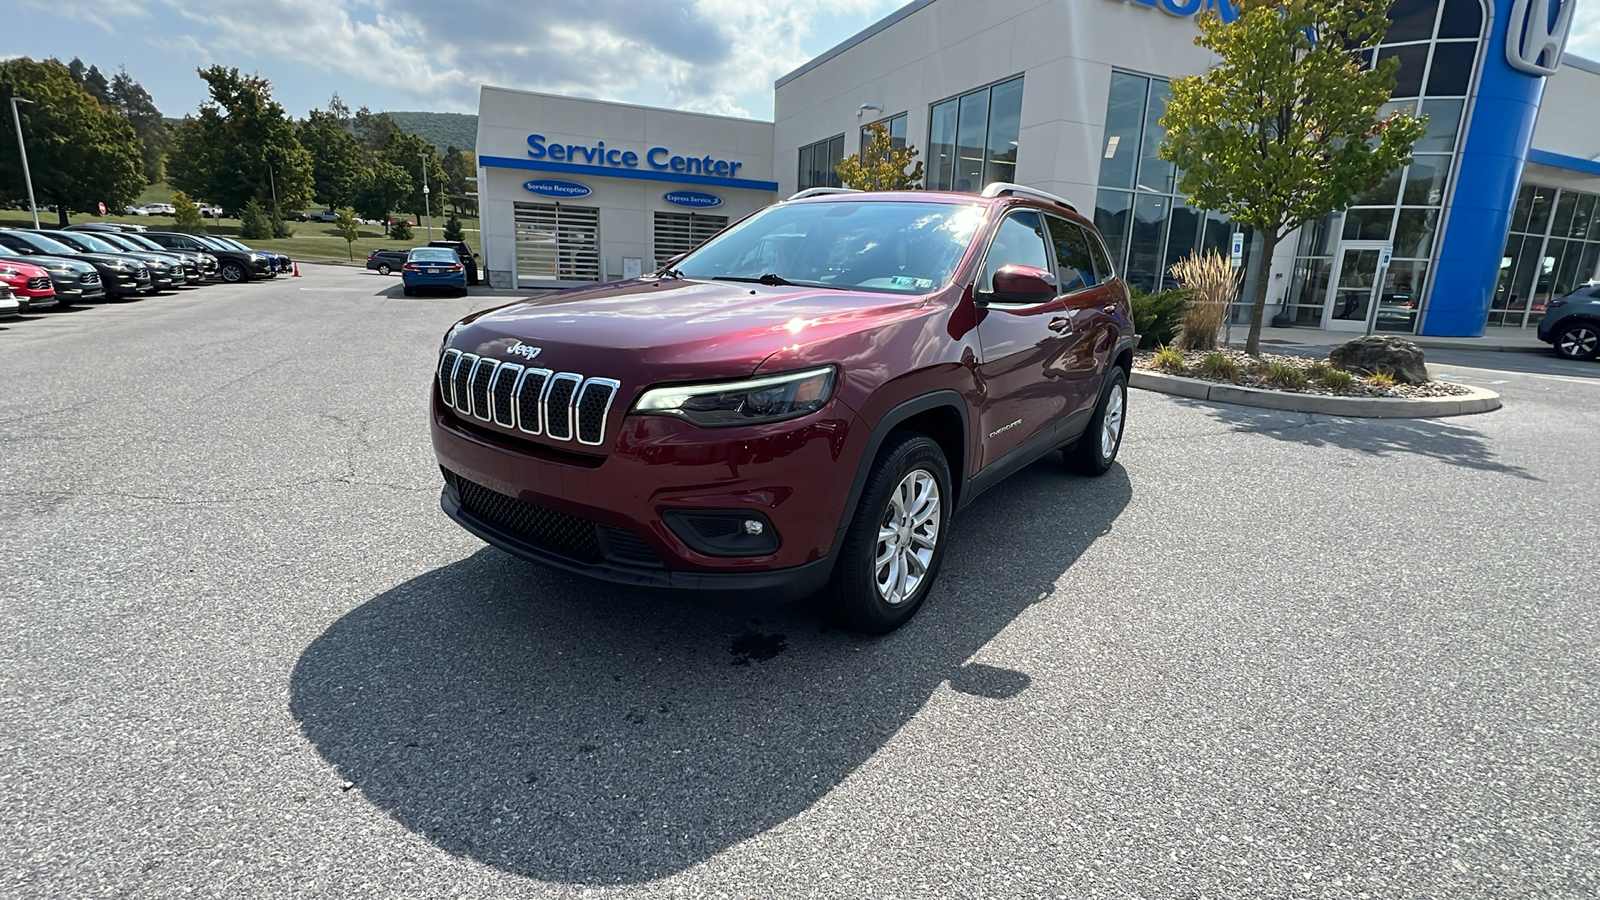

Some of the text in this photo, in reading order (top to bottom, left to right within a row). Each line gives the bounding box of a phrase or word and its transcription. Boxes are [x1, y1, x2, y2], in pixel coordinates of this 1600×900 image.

[527, 134, 743, 177] Service Center
[527, 182, 588, 194] Service Reception
[667, 194, 690, 202] Express
[506, 340, 542, 360] Jeep
